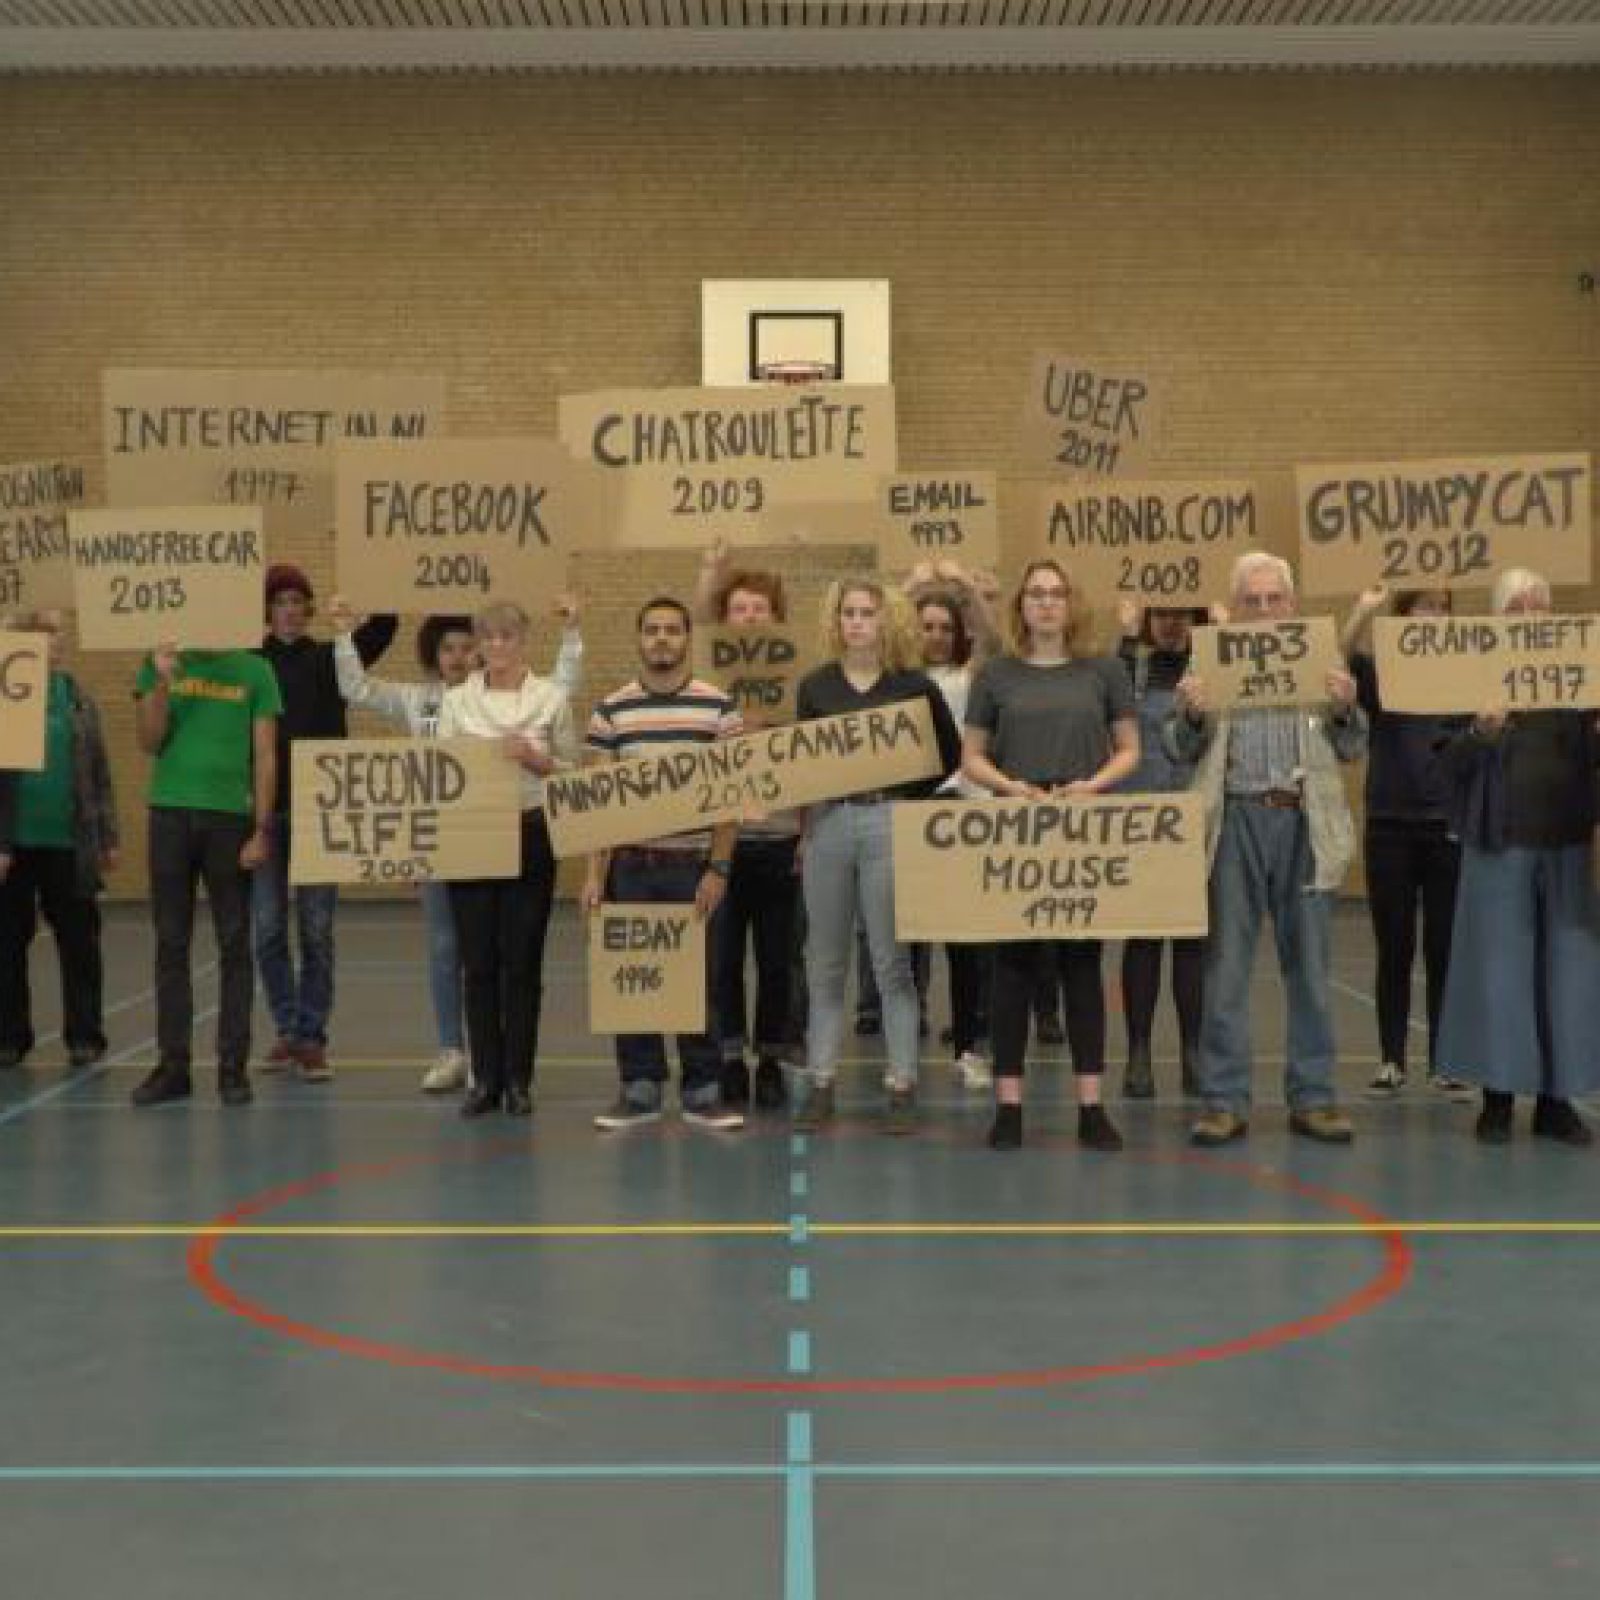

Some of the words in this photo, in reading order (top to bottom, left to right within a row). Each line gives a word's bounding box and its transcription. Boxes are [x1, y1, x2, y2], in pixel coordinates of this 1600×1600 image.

[1044, 363, 1147, 440] UBER
[111, 405, 333, 452] INTERNET
[592, 395, 865, 467] CHATROULETTE
[1056, 429, 1120, 474] 2011
[225, 467, 304, 503] 1997
[672, 477, 765, 514] 2009
[889, 481, 987, 516] EMAIL
[363, 480, 550, 547] FACEBOOK
[1047, 490, 1257, 548] AIRBNB.COM
[1306, 470, 1490, 544] GRUMPY
[1492, 467, 1584, 530] CAT
[910, 520, 964, 547] 1993
[414, 553, 490, 593] 2004
[1381, 531, 1490, 579] 2012
[110, 574, 187, 614] 2013
[1116, 556, 1200, 595] 2008
[712, 637, 795, 667] DVD
[1217, 623, 1308, 670] mp3
[1400, 622, 1498, 656] GRAND
[1504, 619, 1594, 651] THEFT
[1239, 670, 1297, 698] 1993
[1504, 664, 1584, 702] 1997
[315, 749, 466, 809] SECOND
[545, 740, 754, 817] MINDREADING
[767, 710, 921, 764] CAMERA
[321, 809, 440, 854] LIFE
[924, 806, 1186, 848] COMPUTER
[982, 856, 1131, 893] MOUSE
[1022, 896, 1097, 927] 1999
[603, 917, 688, 953] EBAY
[611, 963, 664, 993] 1996
